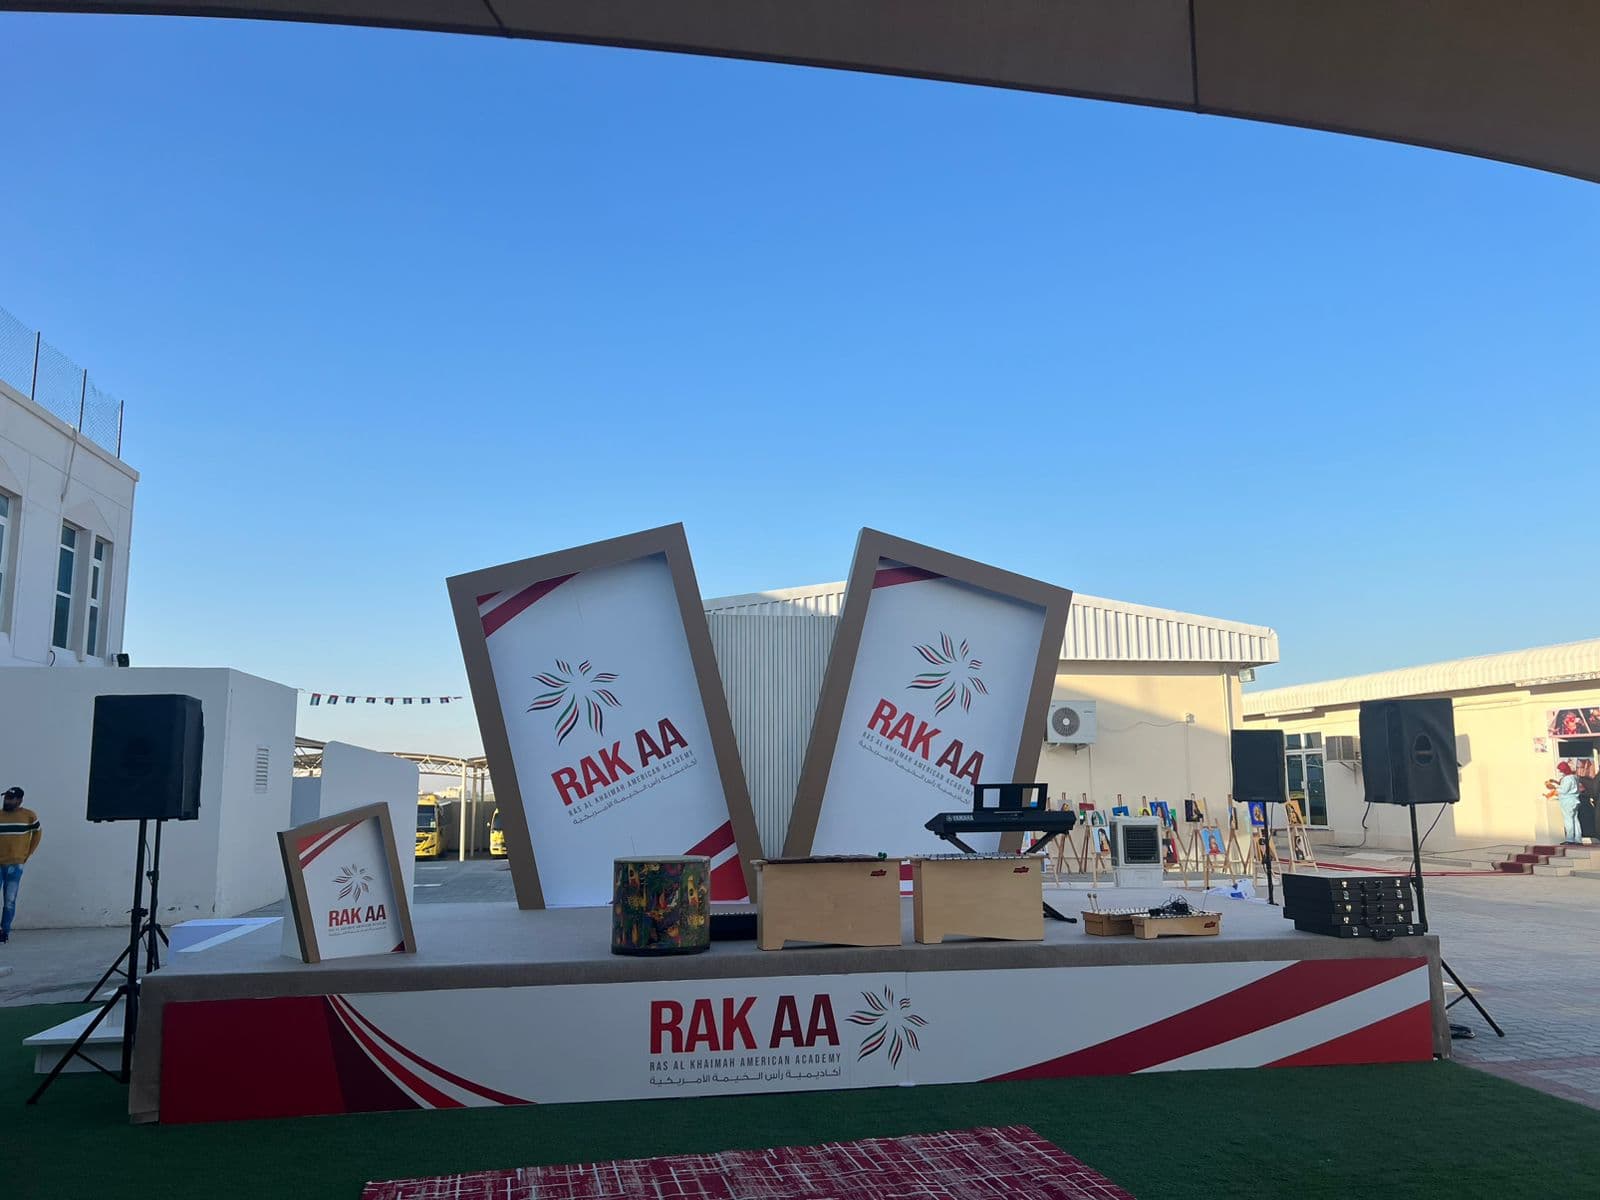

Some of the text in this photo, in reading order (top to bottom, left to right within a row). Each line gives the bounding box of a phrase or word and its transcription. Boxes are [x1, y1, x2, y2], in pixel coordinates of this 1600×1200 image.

[551, 718, 688, 806] RAK AA
[867, 698, 984, 786] RAK AA
[627, 766, 661, 788] AMERICAN
[662, 750, 693, 770] ACADEMY
[328, 907, 361, 927] RAK
[365, 904, 386, 922] AA
[650, 993, 840, 1054] RAK AA
[650, 1053, 840, 1071] RAS AL KHAIMAH AMERICAN ACADEMY
